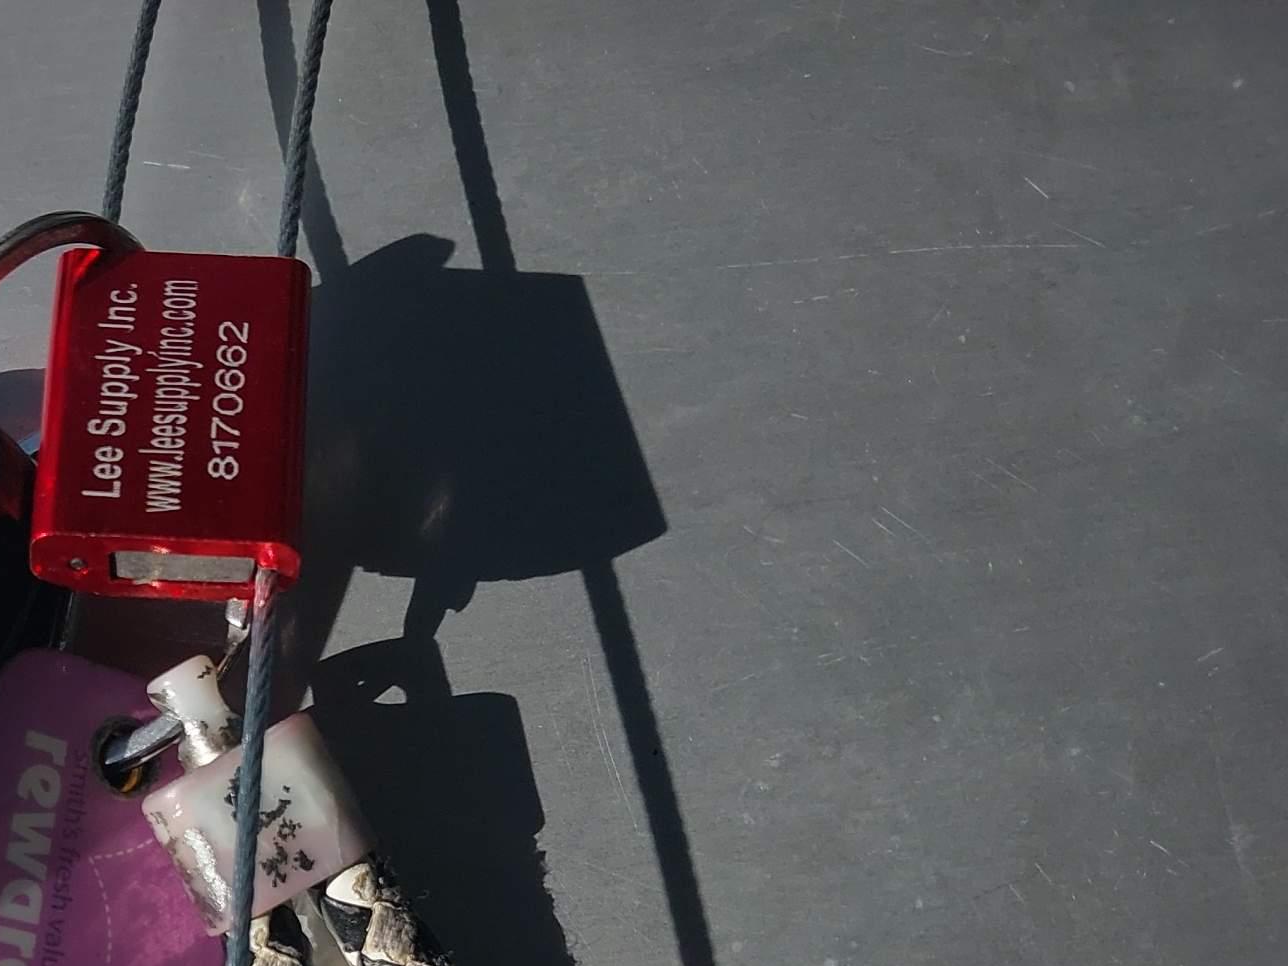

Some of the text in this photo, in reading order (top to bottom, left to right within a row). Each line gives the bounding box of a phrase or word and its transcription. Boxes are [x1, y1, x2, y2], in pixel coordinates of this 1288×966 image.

[81, 283, 143, 498] Lee Supply Inc.
[138, 280, 204, 513] www.leesupplyinc.com
[208, 321, 249, 481] 8170662
[50, 848, 80, 912] fresh
